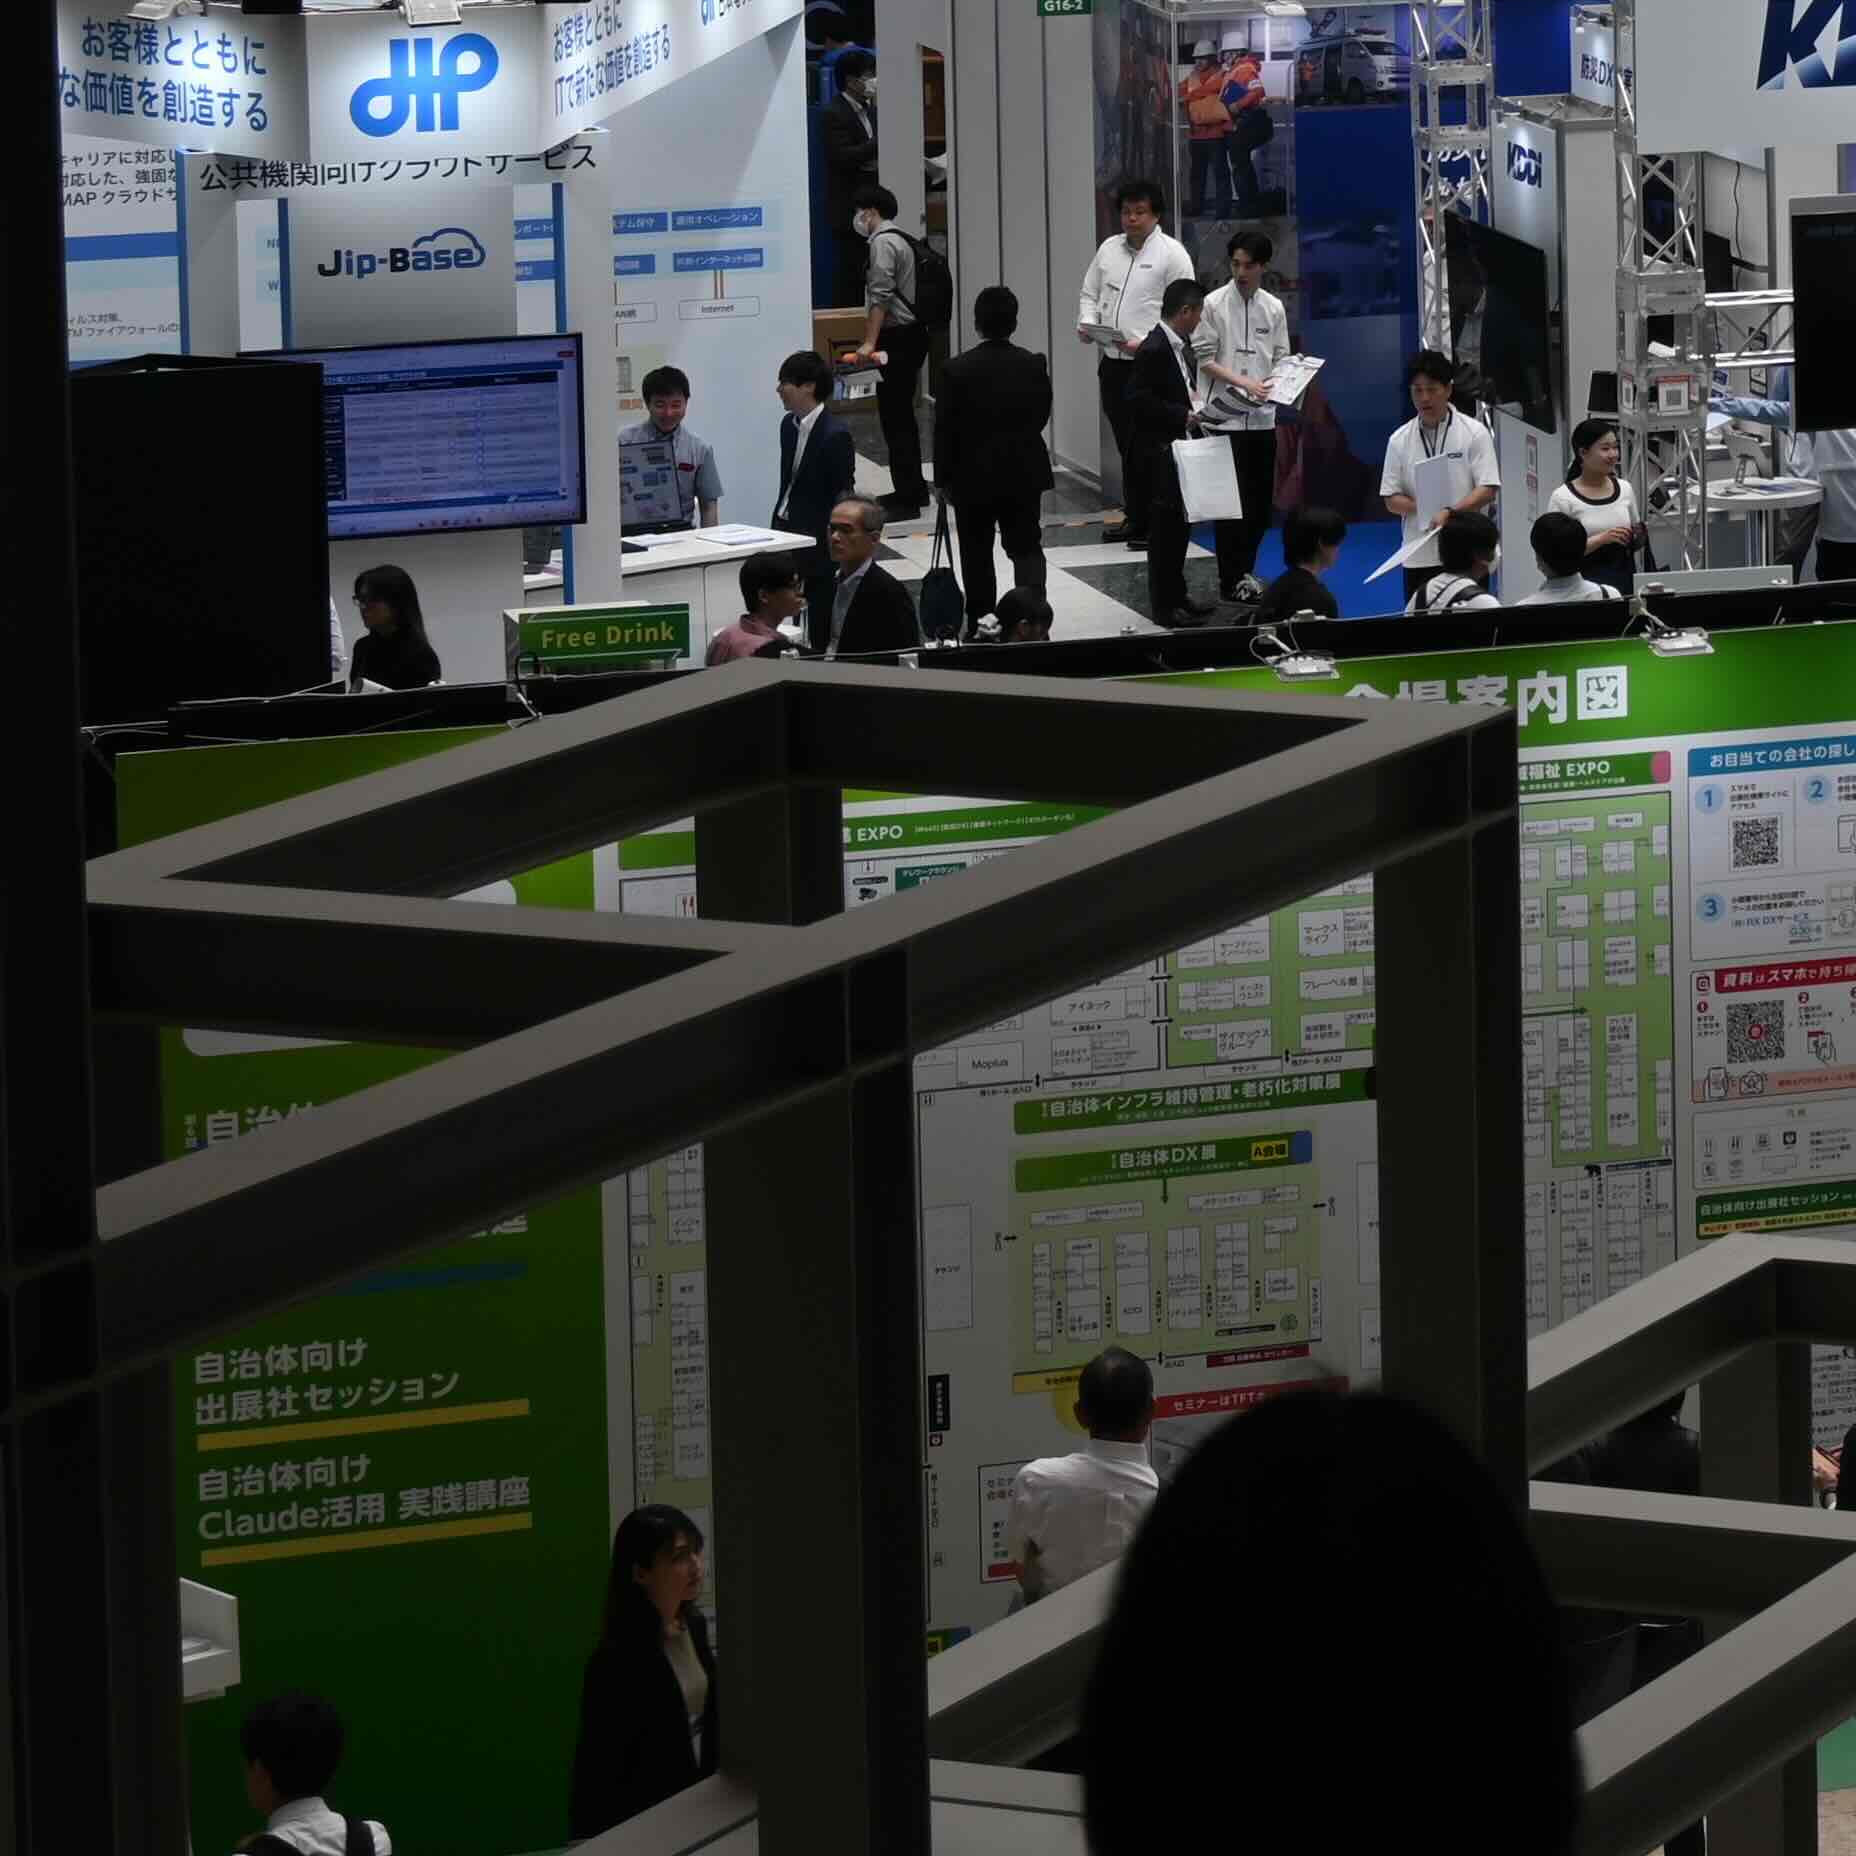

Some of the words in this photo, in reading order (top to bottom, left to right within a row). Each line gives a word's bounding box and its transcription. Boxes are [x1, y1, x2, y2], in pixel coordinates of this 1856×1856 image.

[81, 16, 268, 76] お客様とともに
[1507, 141, 1543, 189] KDDI
[317, 238, 482, 281] Jip-Base
[540, 623, 597, 649] Free
[606, 619, 676, 647] Drink
[1566, 759, 1611, 778] EXPO
[856, 823, 904, 842] EXPO
[193, 1337, 369, 1385] 自治体向け
[194, 1370, 461, 1426] 出展社セッション
[197, 1453, 372, 1502] 自治体向け
[197, 1492, 387, 1541] Claude活用
[397, 1476, 530, 1520] 実践講座
